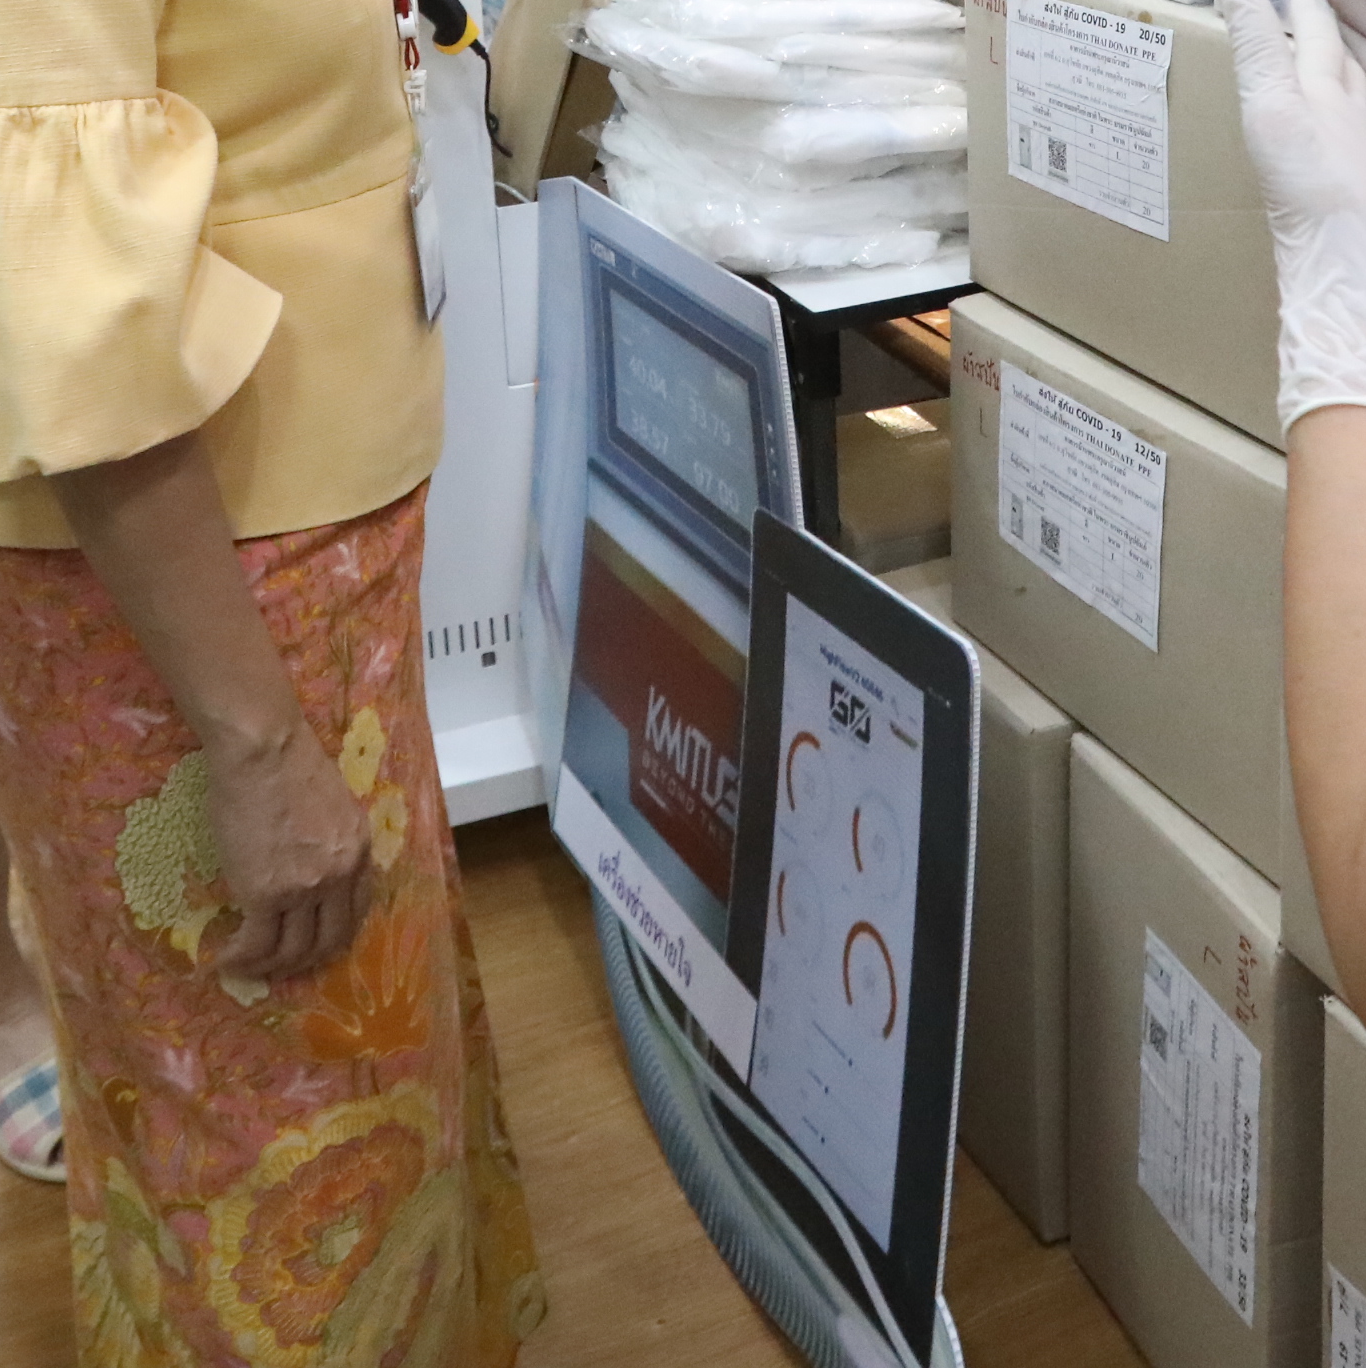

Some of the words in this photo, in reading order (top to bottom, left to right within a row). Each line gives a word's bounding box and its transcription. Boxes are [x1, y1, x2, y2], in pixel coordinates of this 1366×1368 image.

[1081, 11, 1108, 30] COVID
[1115, 21, 1126, 34] 19
[1139, 28, 1166, 46] 20/50
[1090, 34, 1108, 48] THAI
[1108, 39, 1138, 57] DONATE
[1142, 48, 1157, 62] PPE
[1141, 159, 1150, 171] 20
[1142, 205, 1151, 217] 20
[1076, 409, 1102, 430] COVID
[1111, 427, 1122, 442] 19
[1135, 443, 1161, 466] 12/50
[1104, 440, 1134, 467] DONATE
